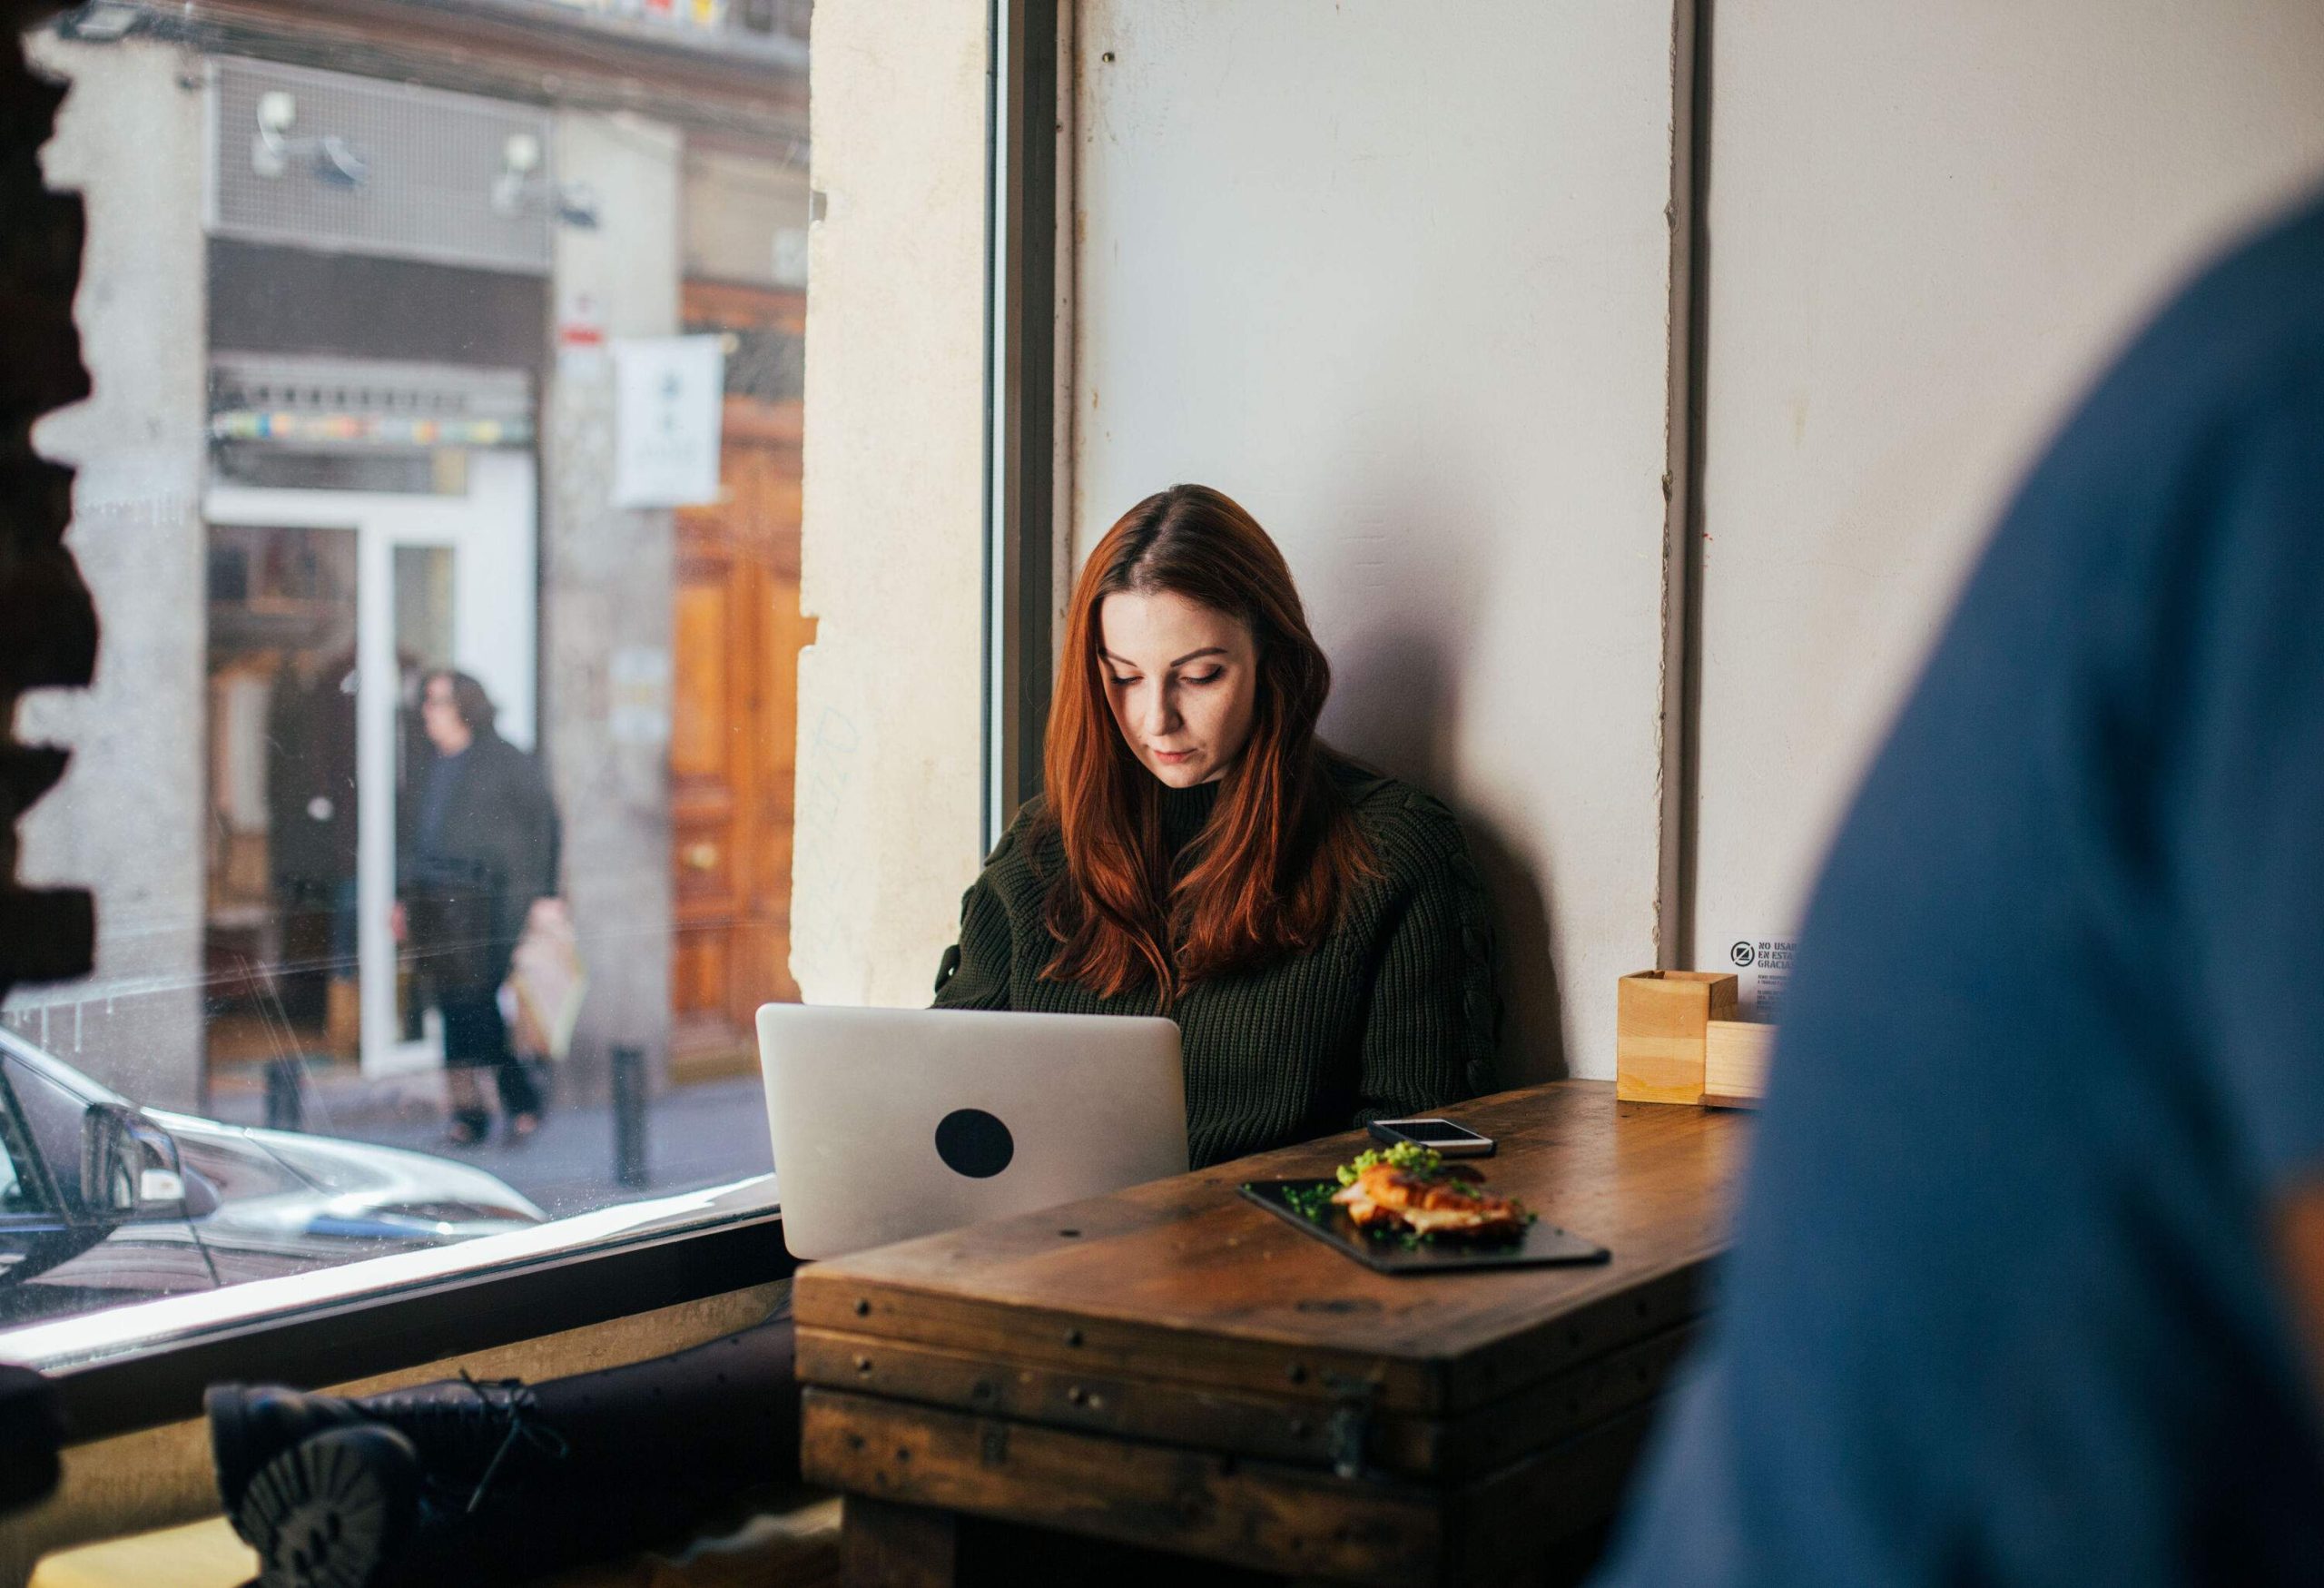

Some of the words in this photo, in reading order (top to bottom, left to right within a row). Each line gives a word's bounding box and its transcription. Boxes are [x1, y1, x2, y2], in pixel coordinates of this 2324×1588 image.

[1758, 942, 1771, 950] NO
[1758, 951, 1769, 959] EN
[1758, 960, 1794, 969] GRACIA
